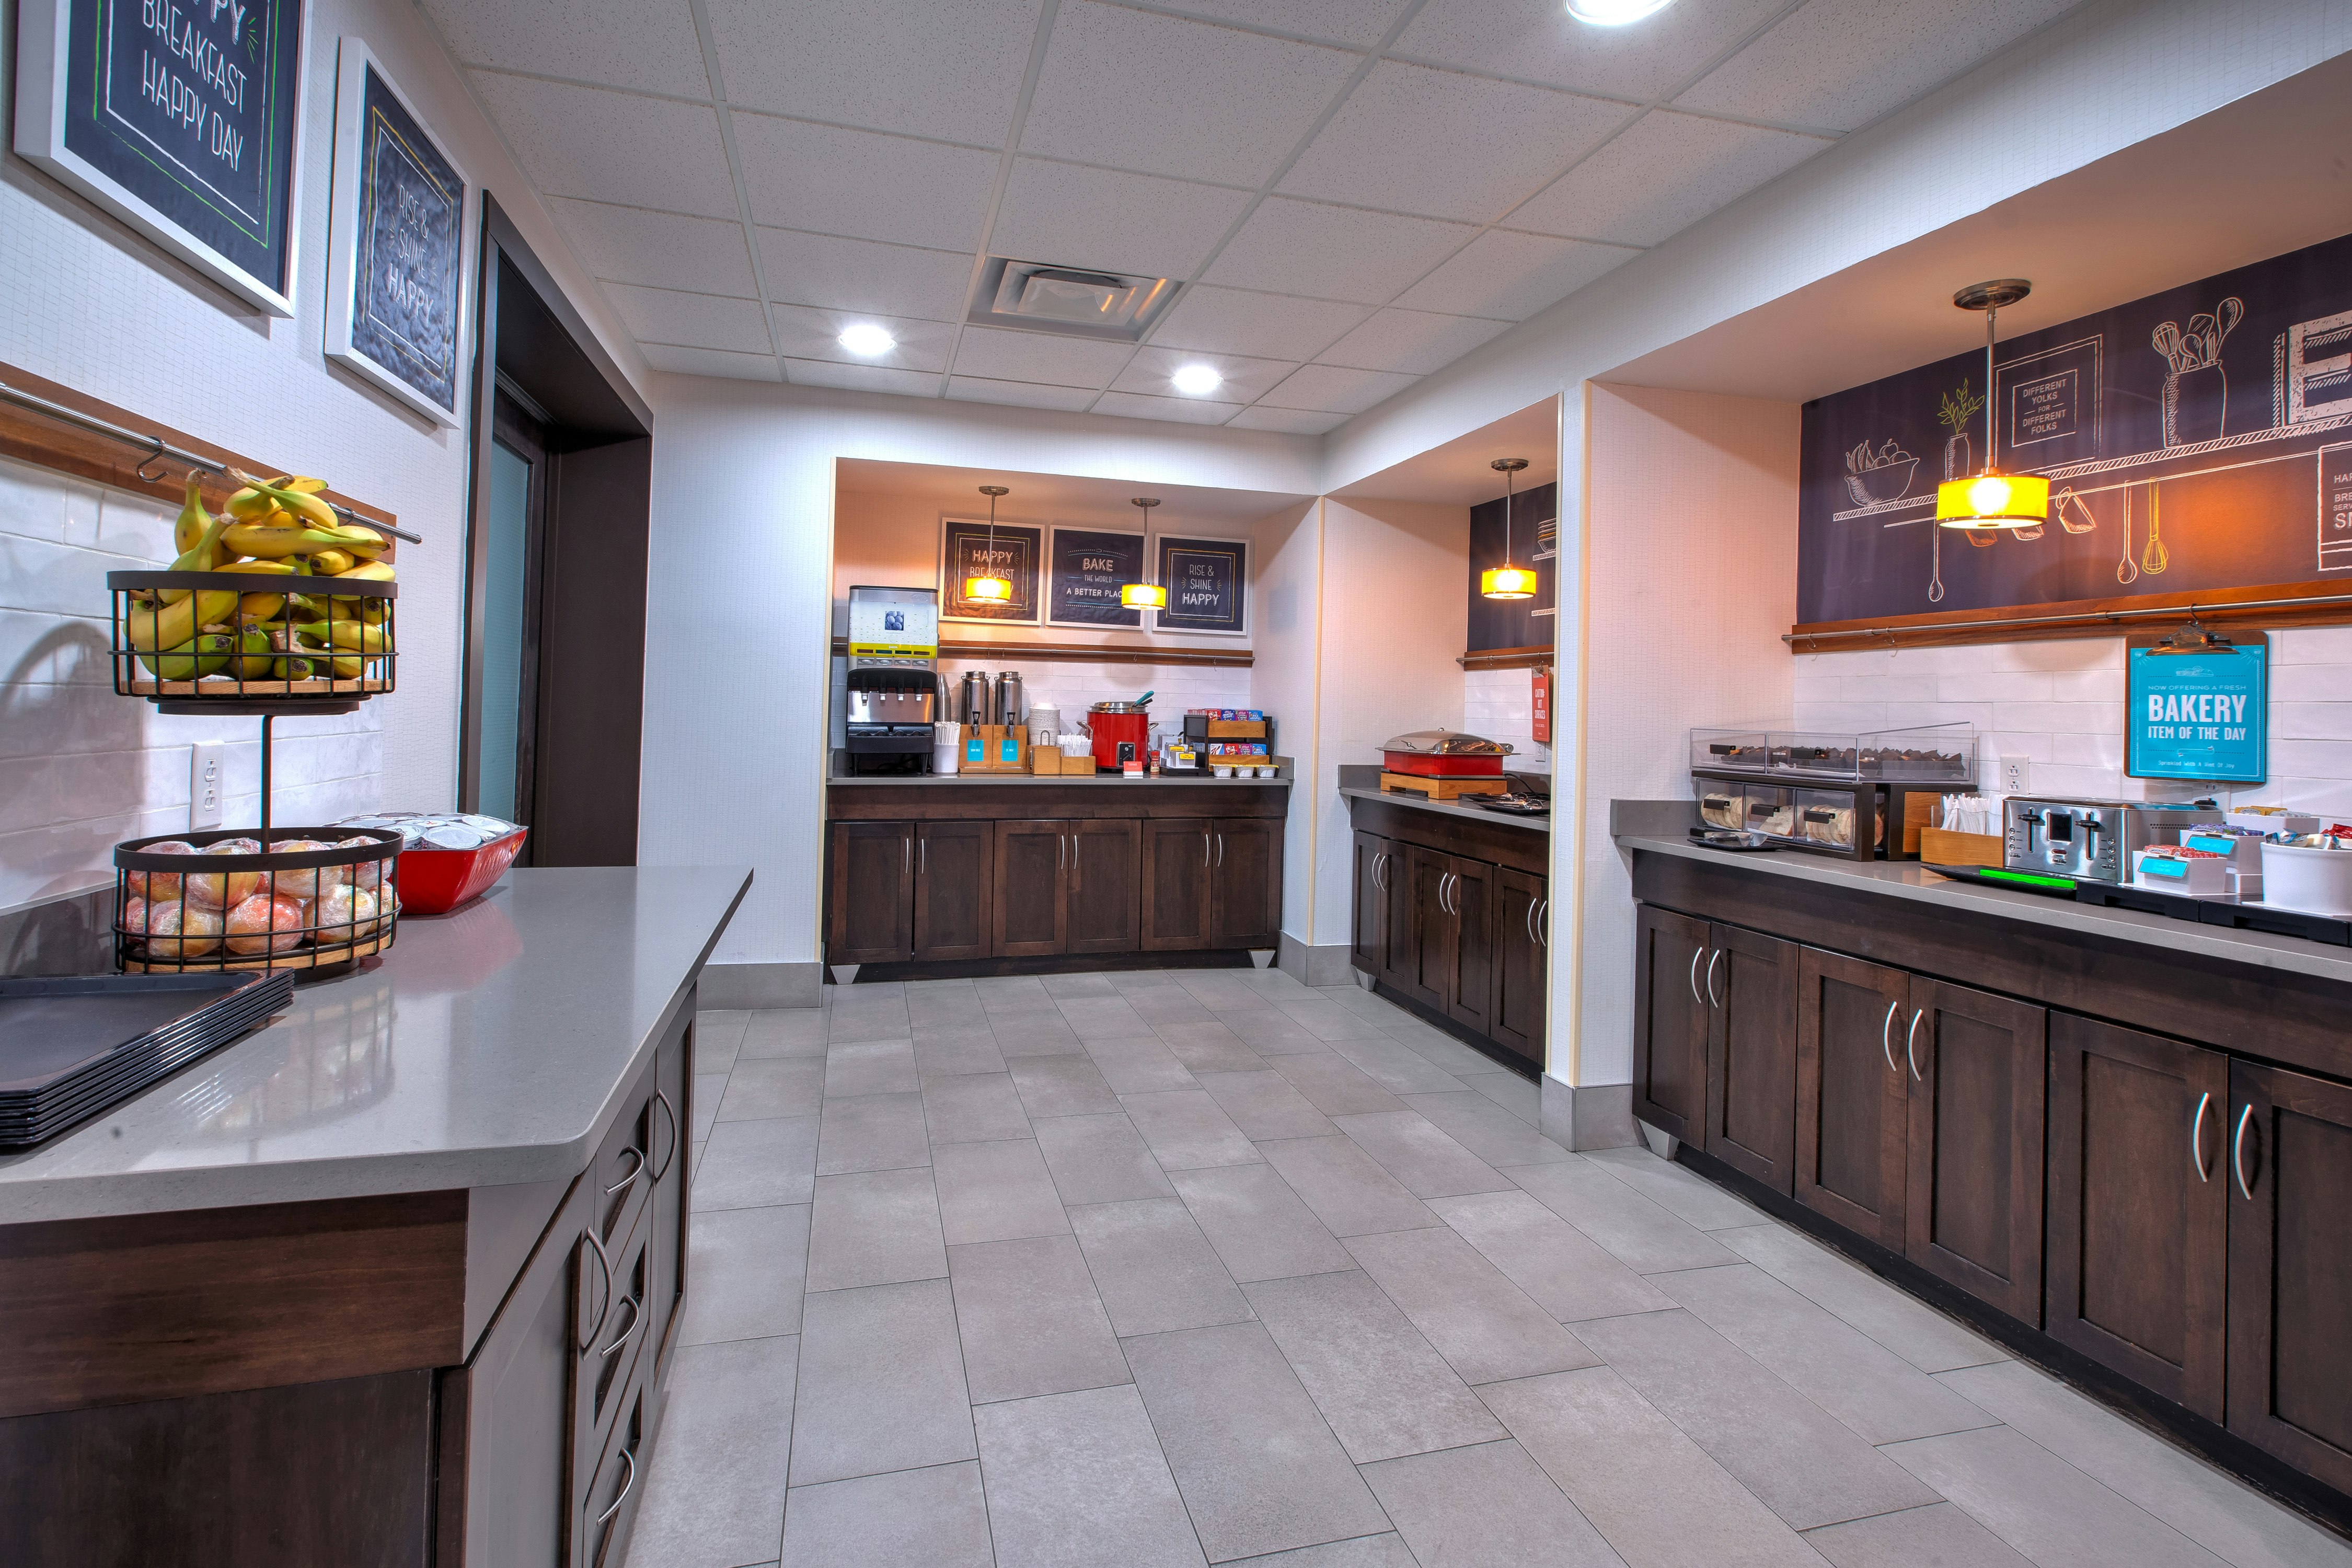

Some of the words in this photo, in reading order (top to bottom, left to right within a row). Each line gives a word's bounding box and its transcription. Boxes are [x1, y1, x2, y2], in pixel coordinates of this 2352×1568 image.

[142, 49, 207, 141] HAPPY
[212, 111, 243, 171] DAY
[399, 184, 420, 231] RISE
[421, 209, 429, 241] &
[398, 228, 426, 279] SHINE
[387, 263, 434, 328] HAPPY
[2023, 378, 2067, 398] DIFFERENT
[2032, 391, 2058, 405] YOLKS
[2038, 405, 2050, 413] FOR
[2022, 409, 2067, 427] DIFFERENT
[2031, 422, 2058, 435] FOLKS
[972, 549, 1013, 564] HAPPY
[1082, 558, 1113, 572] BAKE
[1189, 564, 1205, 576] RISE
[1207, 566, 1214, 577] &
[1075, 588, 1102, 597] BETTER
[1190, 579, 1212, 591] SHINE
[1182, 593, 1219, 606] HAPPY
[2148, 694, 2247, 723] BAKERY
[2148, 726, 2174, 739] ITEM
[2178, 727, 2193, 739] OF
[2197, 727, 2219, 740] THE
[2224, 727, 2246, 741] DAY
